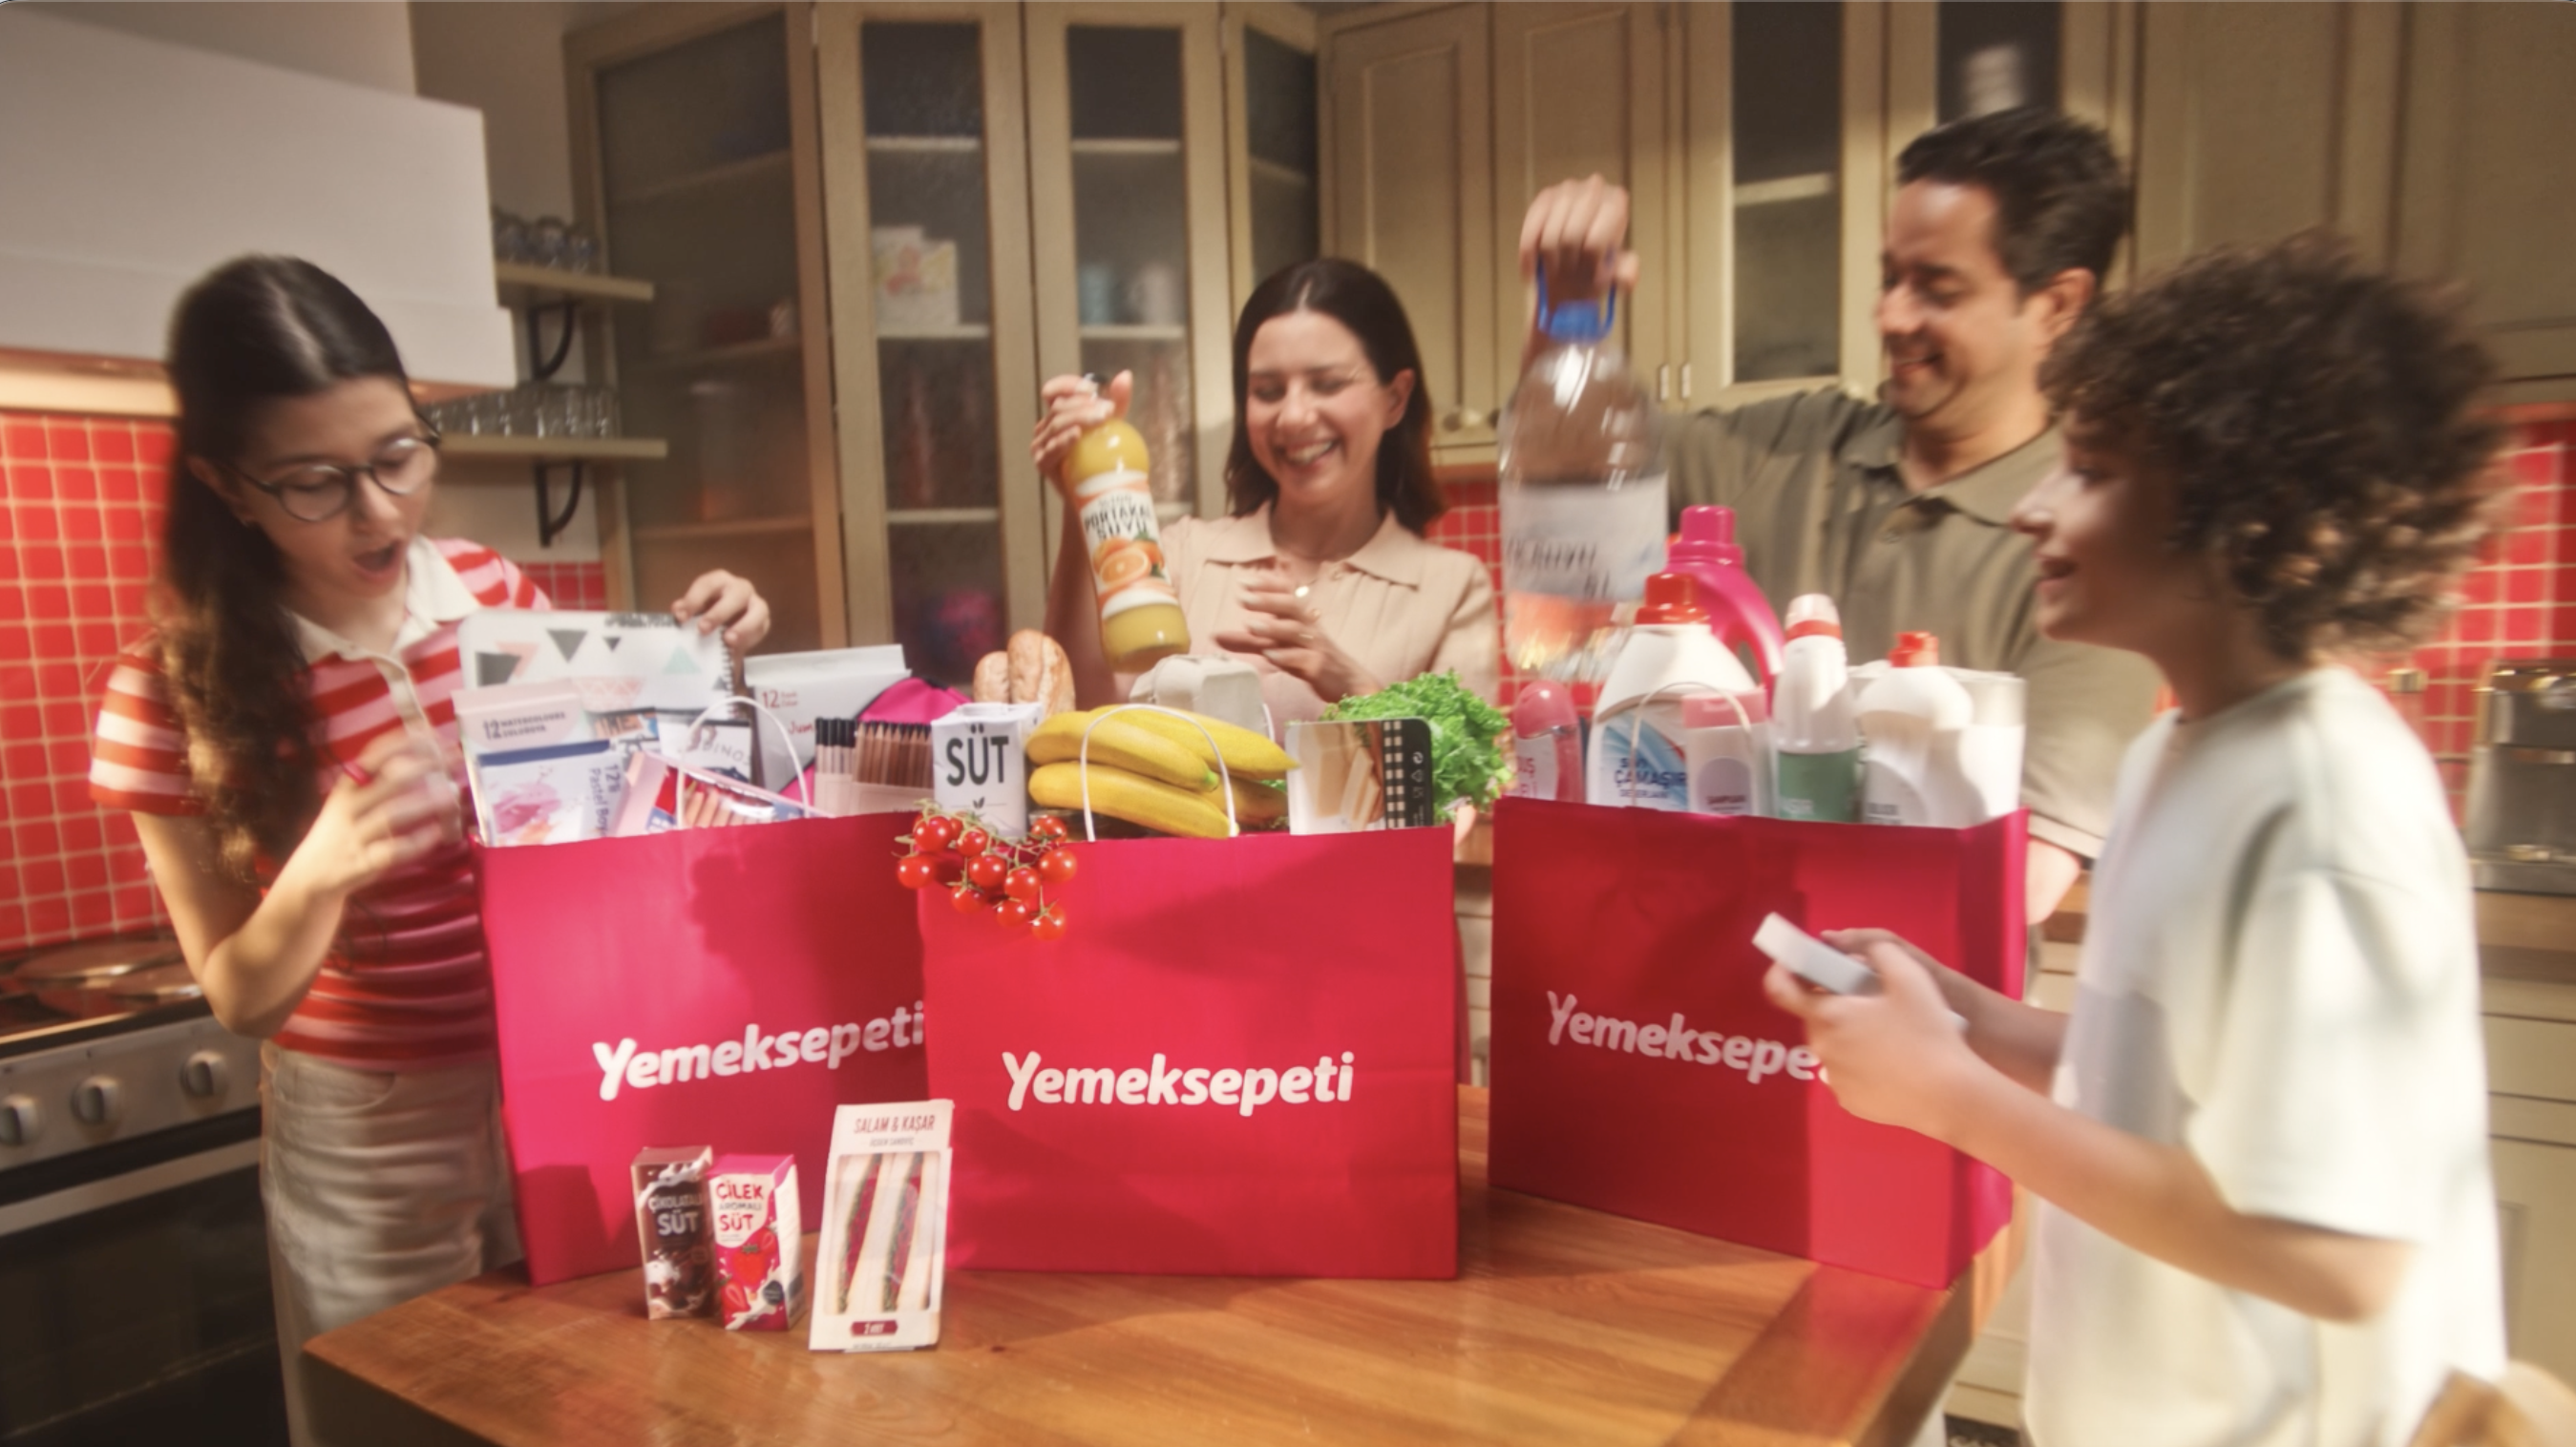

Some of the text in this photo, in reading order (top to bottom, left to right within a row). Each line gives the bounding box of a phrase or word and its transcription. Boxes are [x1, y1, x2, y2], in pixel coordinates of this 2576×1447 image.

[763, 689, 780, 708] 12
[483, 718, 502, 742] 12
[788, 720, 814, 735] Jum
[946, 723, 1009, 786] SÜT
[1547, 990, 1828, 1085] Yemeksepe
[592, 999, 924, 1101] Yemeksepeti
[1002, 1050, 1355, 1117] Yemeksepeti
[854, 1114, 936, 1135] SALAM & KAŞAR
[716, 1179, 764, 1203] ÇİLEK
[718, 1202, 763, 1212] AROMALI
[657, 1207, 698, 1236] SÜT
[719, 1211, 753, 1232] SÜT
